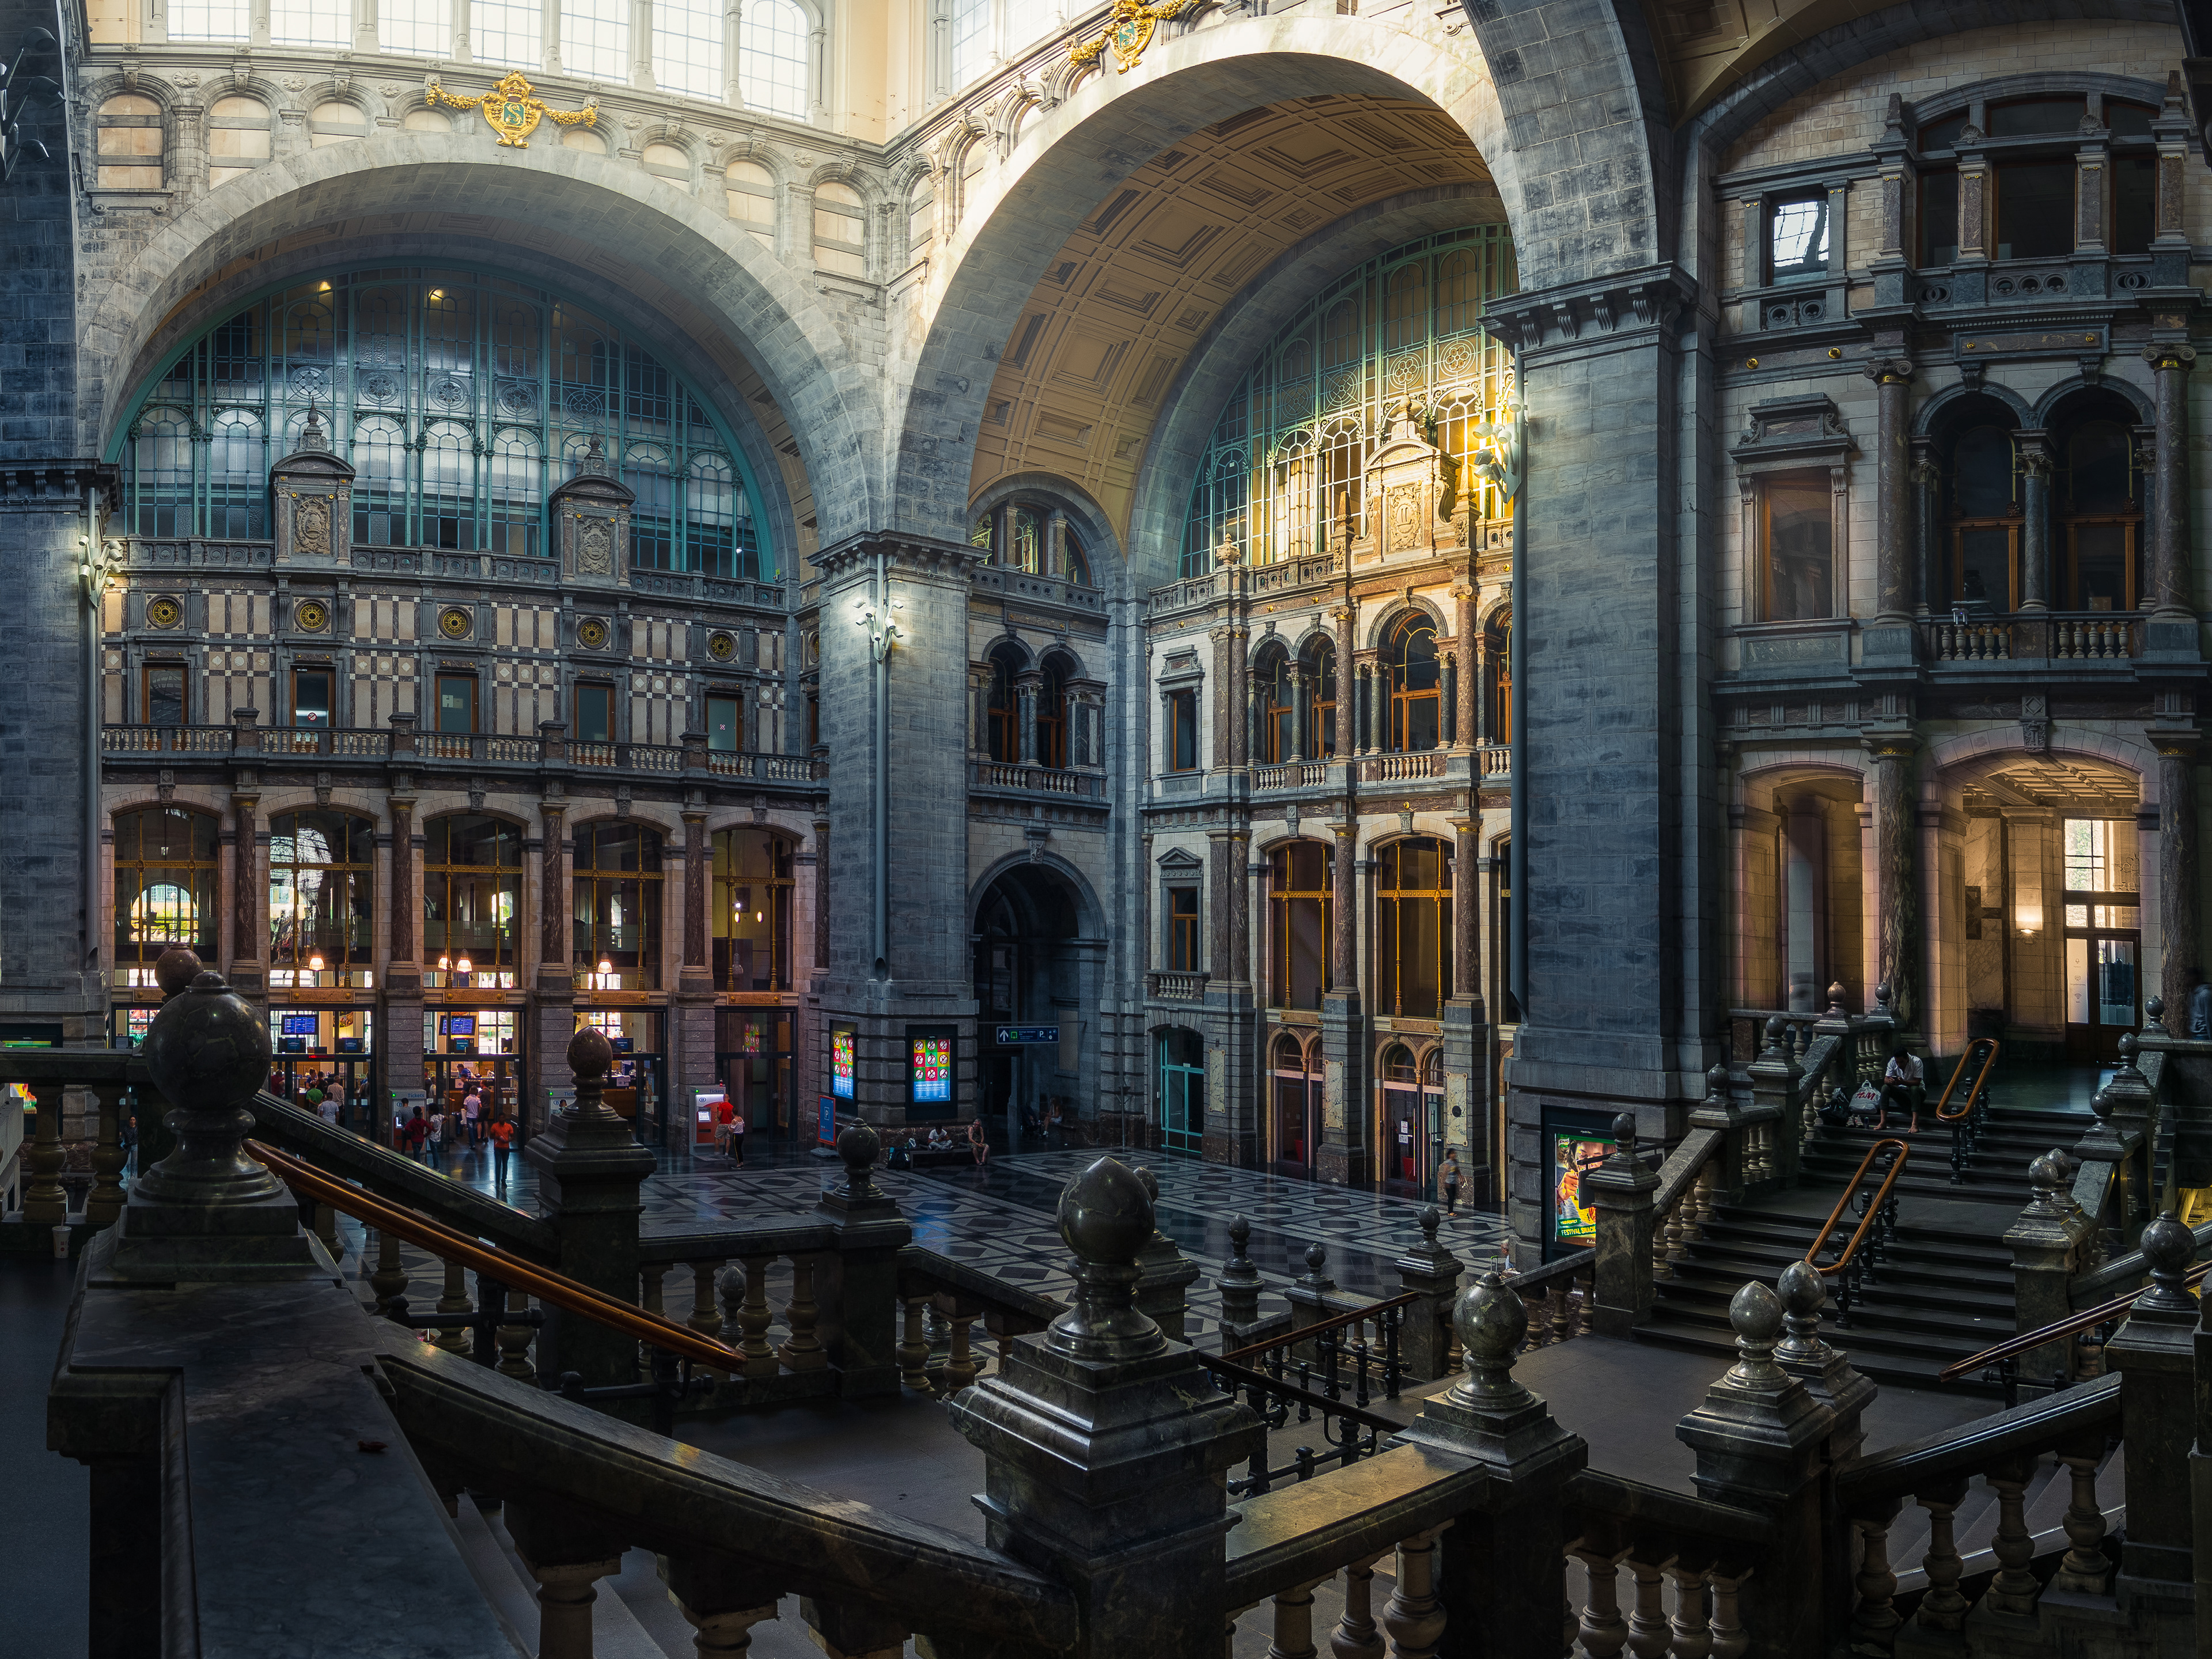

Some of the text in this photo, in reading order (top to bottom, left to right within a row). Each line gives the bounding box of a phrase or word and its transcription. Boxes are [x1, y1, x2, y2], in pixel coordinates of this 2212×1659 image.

[1856, 1092, 1876, 1100] H&M
[825, 1109, 829, 1118] P
[1561, 1228, 1581, 1236] FESTIVAL
